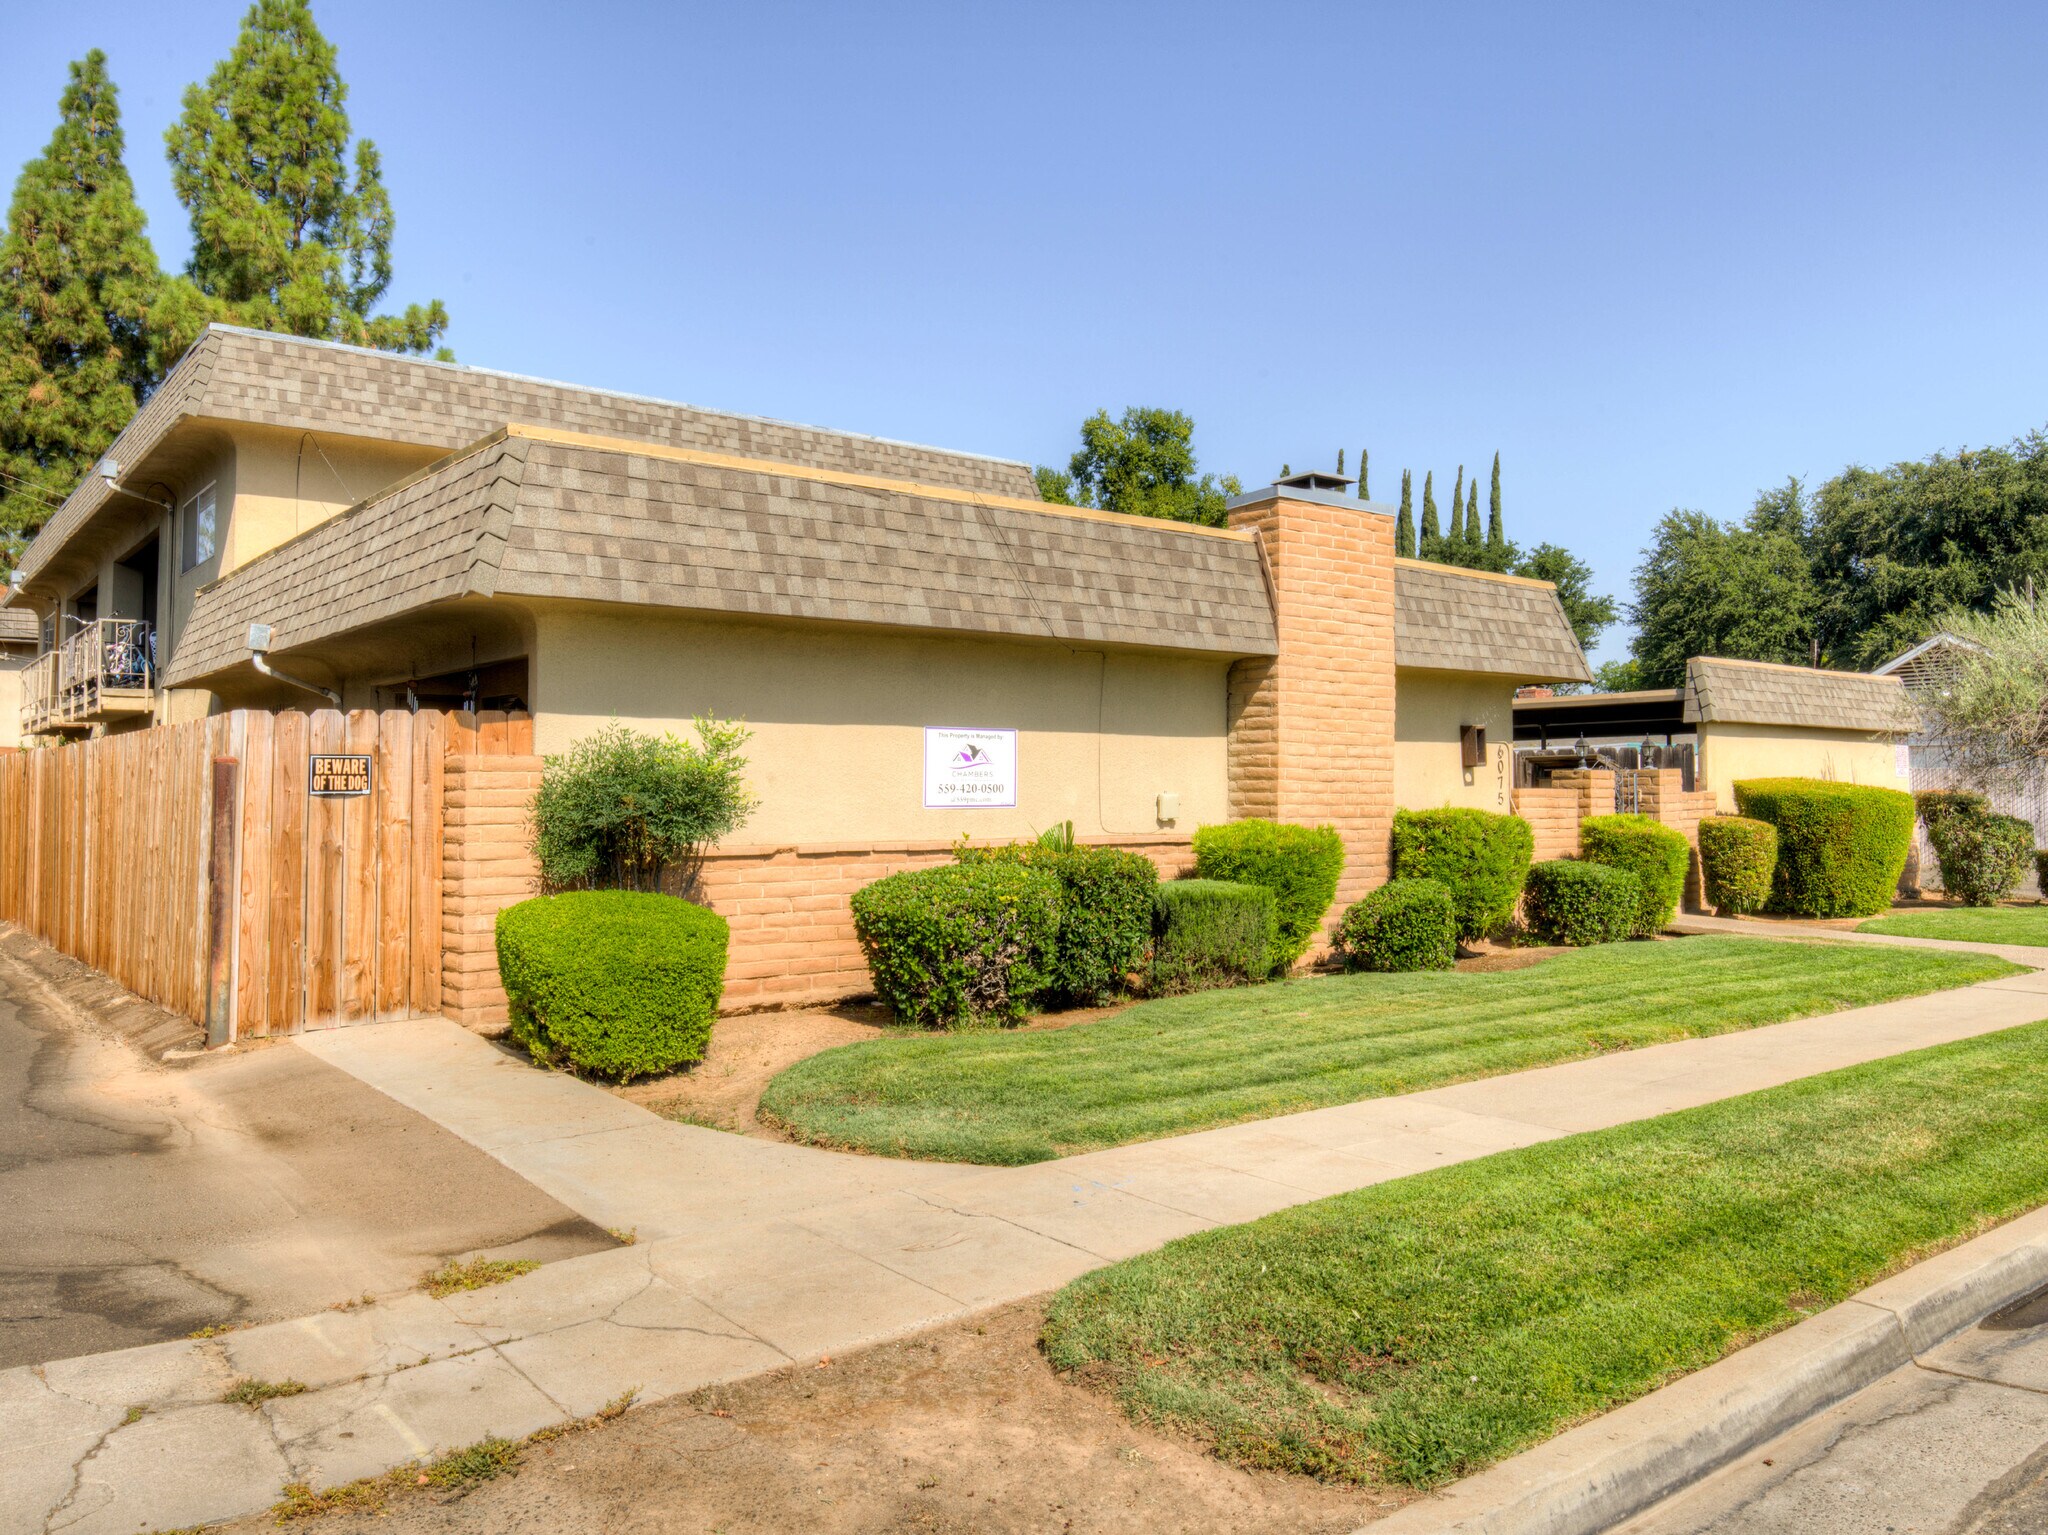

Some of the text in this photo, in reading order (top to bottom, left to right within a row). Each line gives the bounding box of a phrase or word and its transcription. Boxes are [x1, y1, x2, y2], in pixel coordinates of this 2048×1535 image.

[949, 732, 970, 740] Property
[976, 733, 997, 741] Managed
[315, 758, 367, 775] BEWARE
[951, 770, 994, 778] CHAMBERS
[313, 775, 368, 791] OF THE DOG
[937, 783, 1005, 794] 559-420-0500
